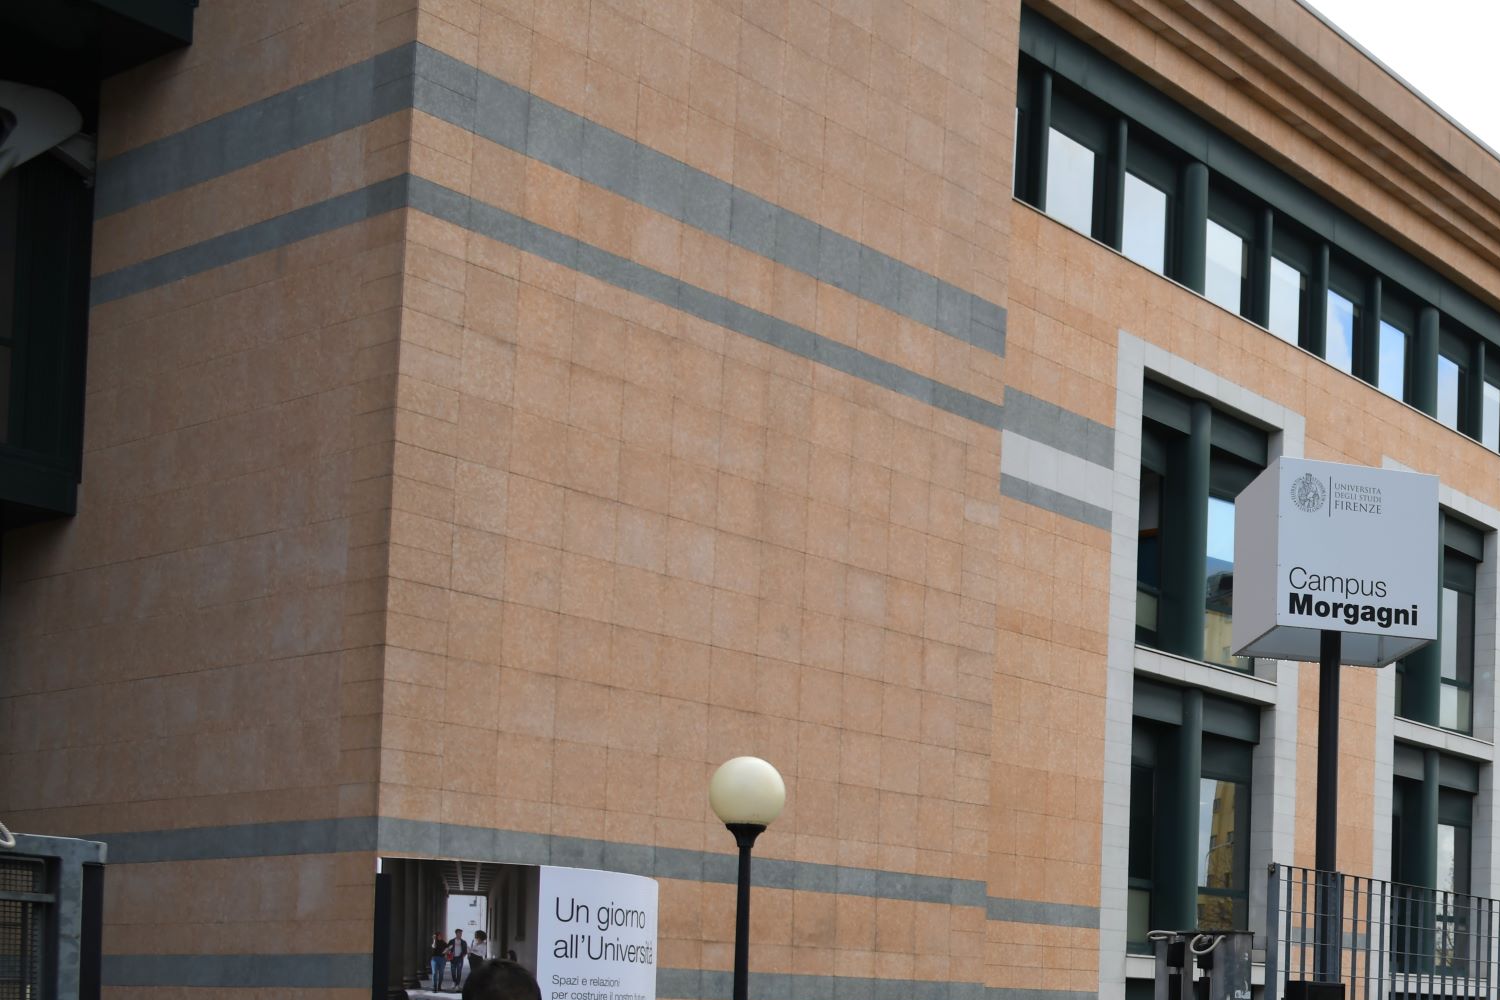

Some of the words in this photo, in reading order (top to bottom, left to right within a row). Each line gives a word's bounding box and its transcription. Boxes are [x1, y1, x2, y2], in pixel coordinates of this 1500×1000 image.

[1334, 491, 1356, 500] DEGLI
[1360, 494, 1382, 503] STUDI
[1334, 500, 1382, 514] FIRENZE
[1289, 566, 1387, 599] Campus
[1289, 593, 1418, 628] Morgagni
[556, 897, 589, 923] Un
[597, 901, 645, 931] giorno
[552, 975, 579, 986] Spazi
[590, 977, 620, 987] relazioni
[552, 992, 568, 1000] per
[571, 992, 608, 1000] costruire
